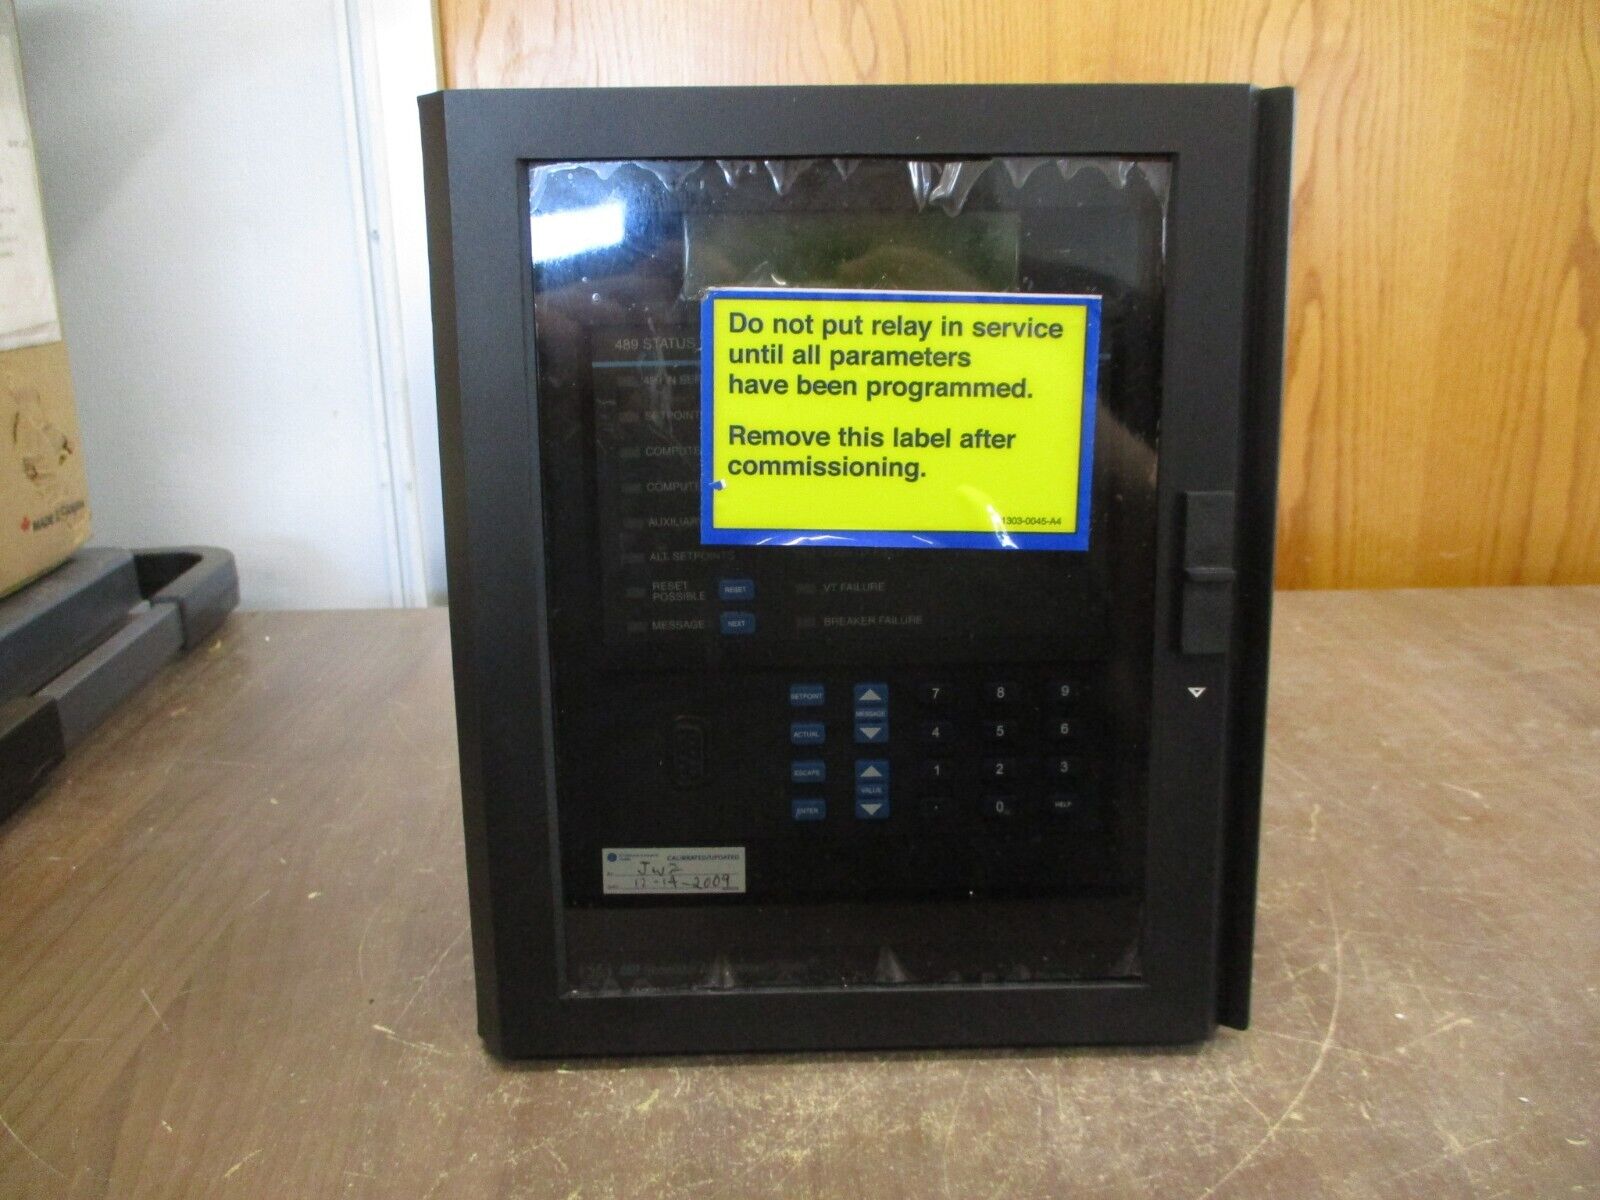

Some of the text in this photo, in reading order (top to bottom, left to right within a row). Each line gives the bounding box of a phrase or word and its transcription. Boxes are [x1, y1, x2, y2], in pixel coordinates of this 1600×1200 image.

[728, 311, 1064, 342] Do not put relay in service
[614, 337, 696, 351] 489 STATUS
[728, 343, 972, 371] until all parameters
[728, 373, 1034, 401] have been programmed.
[728, 424, 1017, 449] Remove this label after
[727, 456, 927, 482] commissioning.
[652, 580, 688, 591] RESET
[724, 585, 747, 593] RESET
[840, 582, 886, 592] FAILURE
[652, 591, 706, 602] POSSIBLE
[652, 620, 705, 631] MESSAGE
[727, 619, 746, 628] NEXT
[823, 615, 923, 626] BREAKER FAILURE
[931, 687, 941, 699] 7
[996, 686, 1005, 699] 8
[1060, 684, 1070, 697] 9
[793, 730, 820, 739] ACTUAL
[931, 726, 940, 738] 4
[996, 725, 1005, 737] 5
[1060, 722, 1069, 735] 6
[933, 764, 940, 776] 1
[996, 762, 1005, 775] 2
[1060, 761, 1069, 774] 3
[995, 800, 1004, 812] 0
[1055, 800, 1073, 809] HELP
